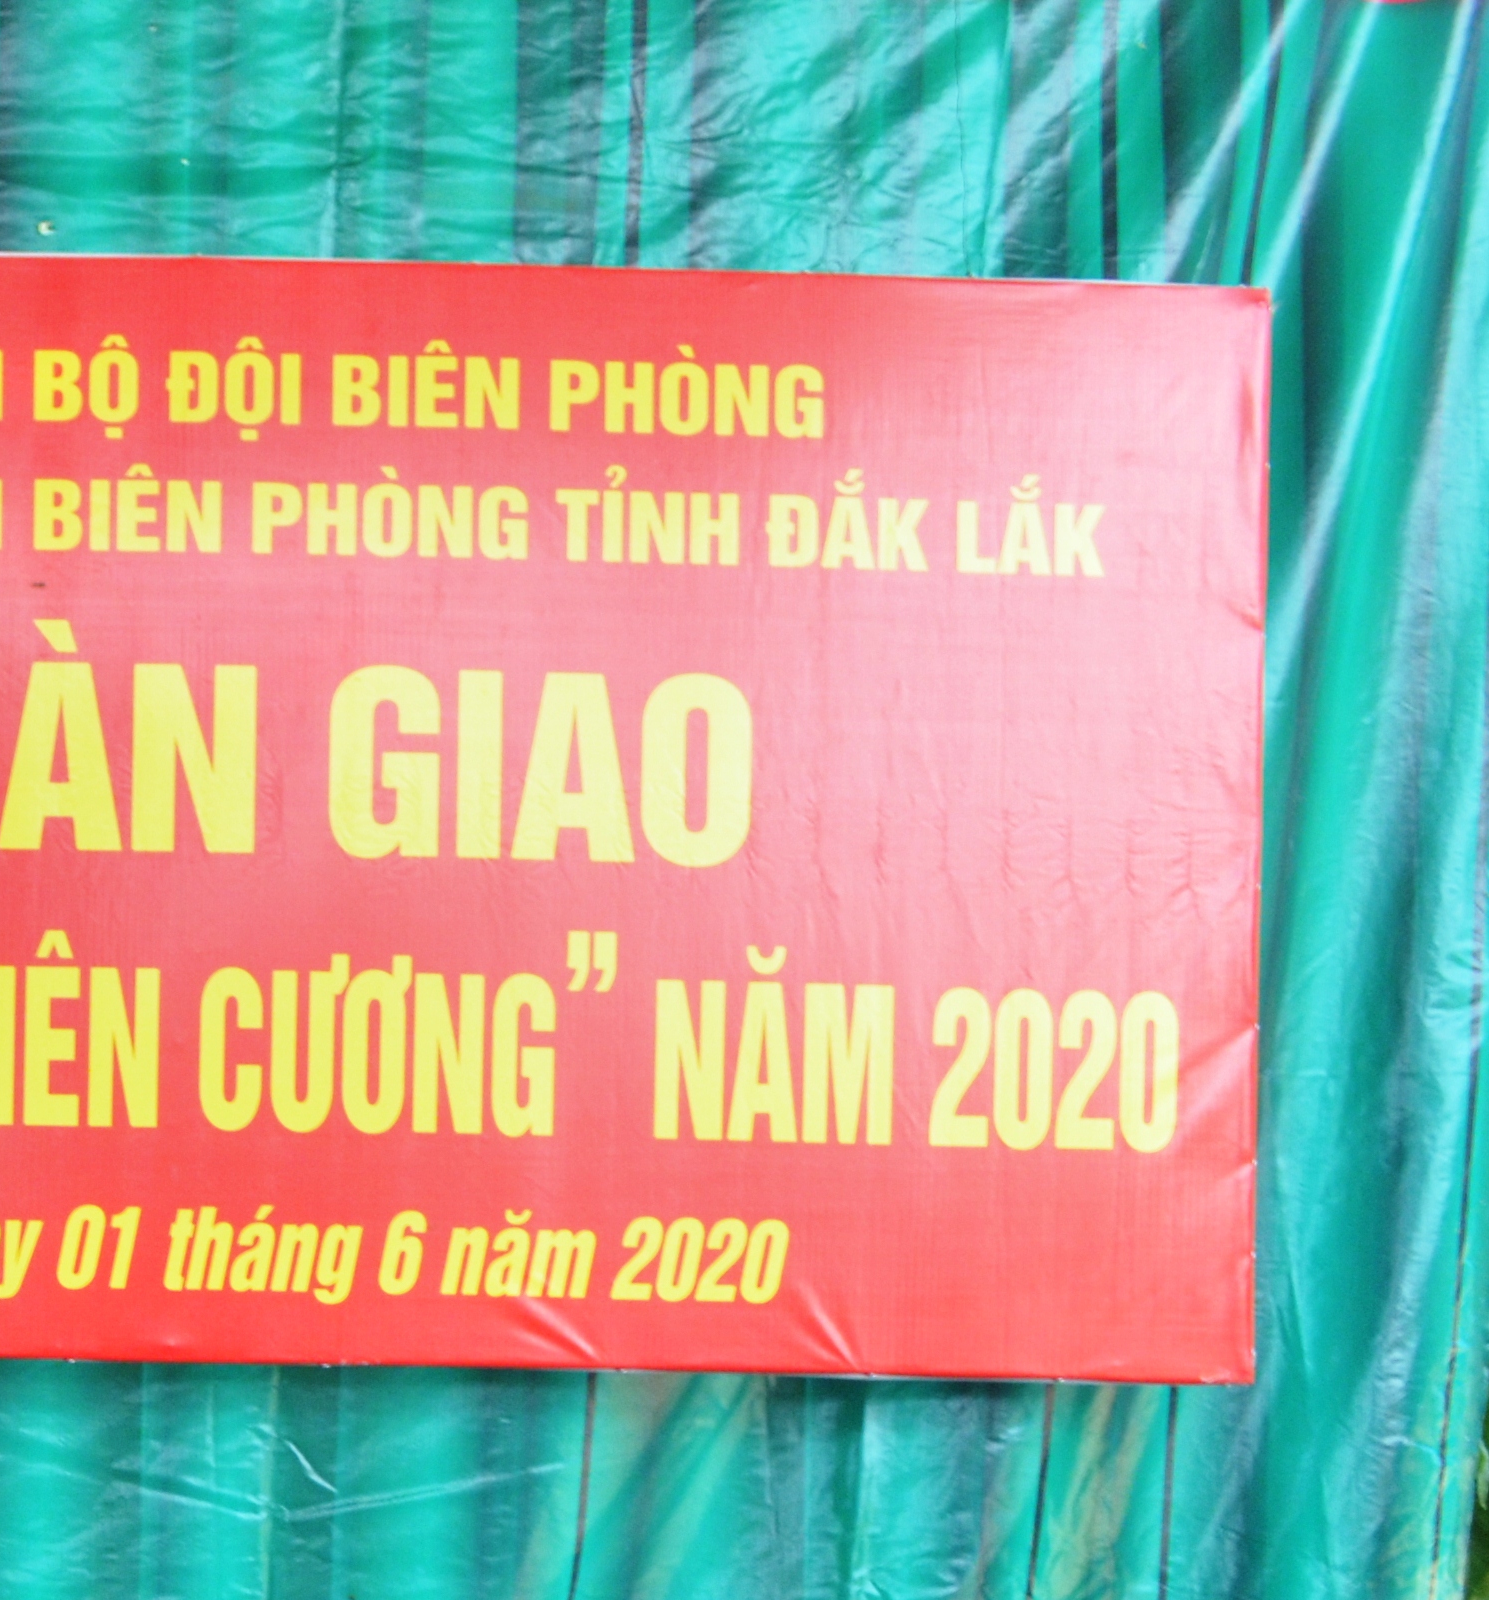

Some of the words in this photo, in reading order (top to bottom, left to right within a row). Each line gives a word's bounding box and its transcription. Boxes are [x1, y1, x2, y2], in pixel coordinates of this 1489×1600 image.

[33, 334, 140, 440] BỘ
[165, 336, 302, 442] ĐỘI
[331, 339, 521, 431] BIÊN
[549, 343, 826, 439] PHÒNG
[32, 462, 224, 553] BIÊN
[252, 465, 529, 560] PHÒNG
[555, 464, 741, 566] TỈNH
[766, 468, 927, 570] ĐẮK
[956, 473, 1106, 577] LẮK
[328, 664, 753, 868] GIAO
[198, 929, 619, 1139] CƯƠNG”
[652, 944, 896, 1146] NĂM
[928, 986, 1180, 1153] 2020
[56, 1204, 142, 1290] 01
[163, 1204, 364, 1305] tháng
[378, 1209, 428, 1296] 6
[439, 1208, 597, 1300] năm
[609, 1215, 791, 1304] 2020
